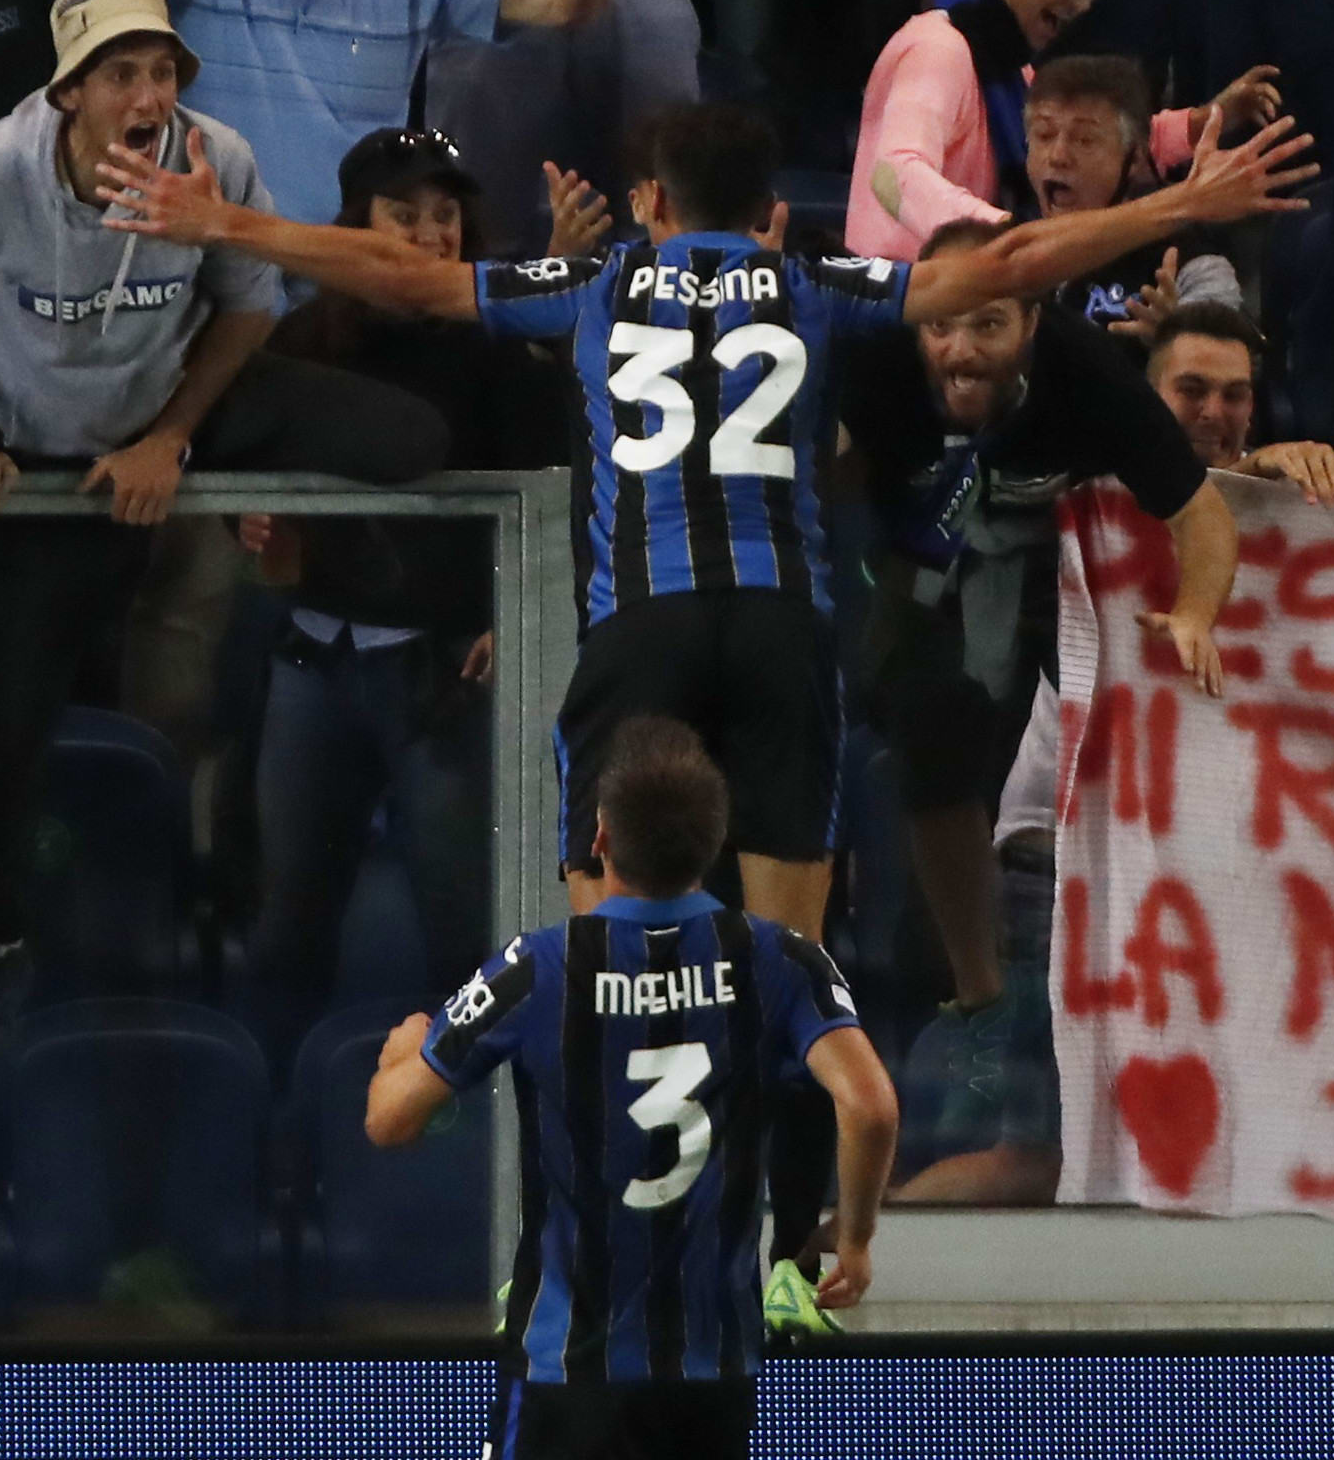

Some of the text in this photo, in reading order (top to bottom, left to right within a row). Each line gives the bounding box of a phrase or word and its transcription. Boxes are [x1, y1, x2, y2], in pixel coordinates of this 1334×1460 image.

[627, 264, 778, 304] PESSINA
[607, 322, 808, 480] 32
[595, 960, 737, 1018] MÆHLE
[1062, 874, 1225, 1029] LA
[622, 1041, 715, 1210] 3
